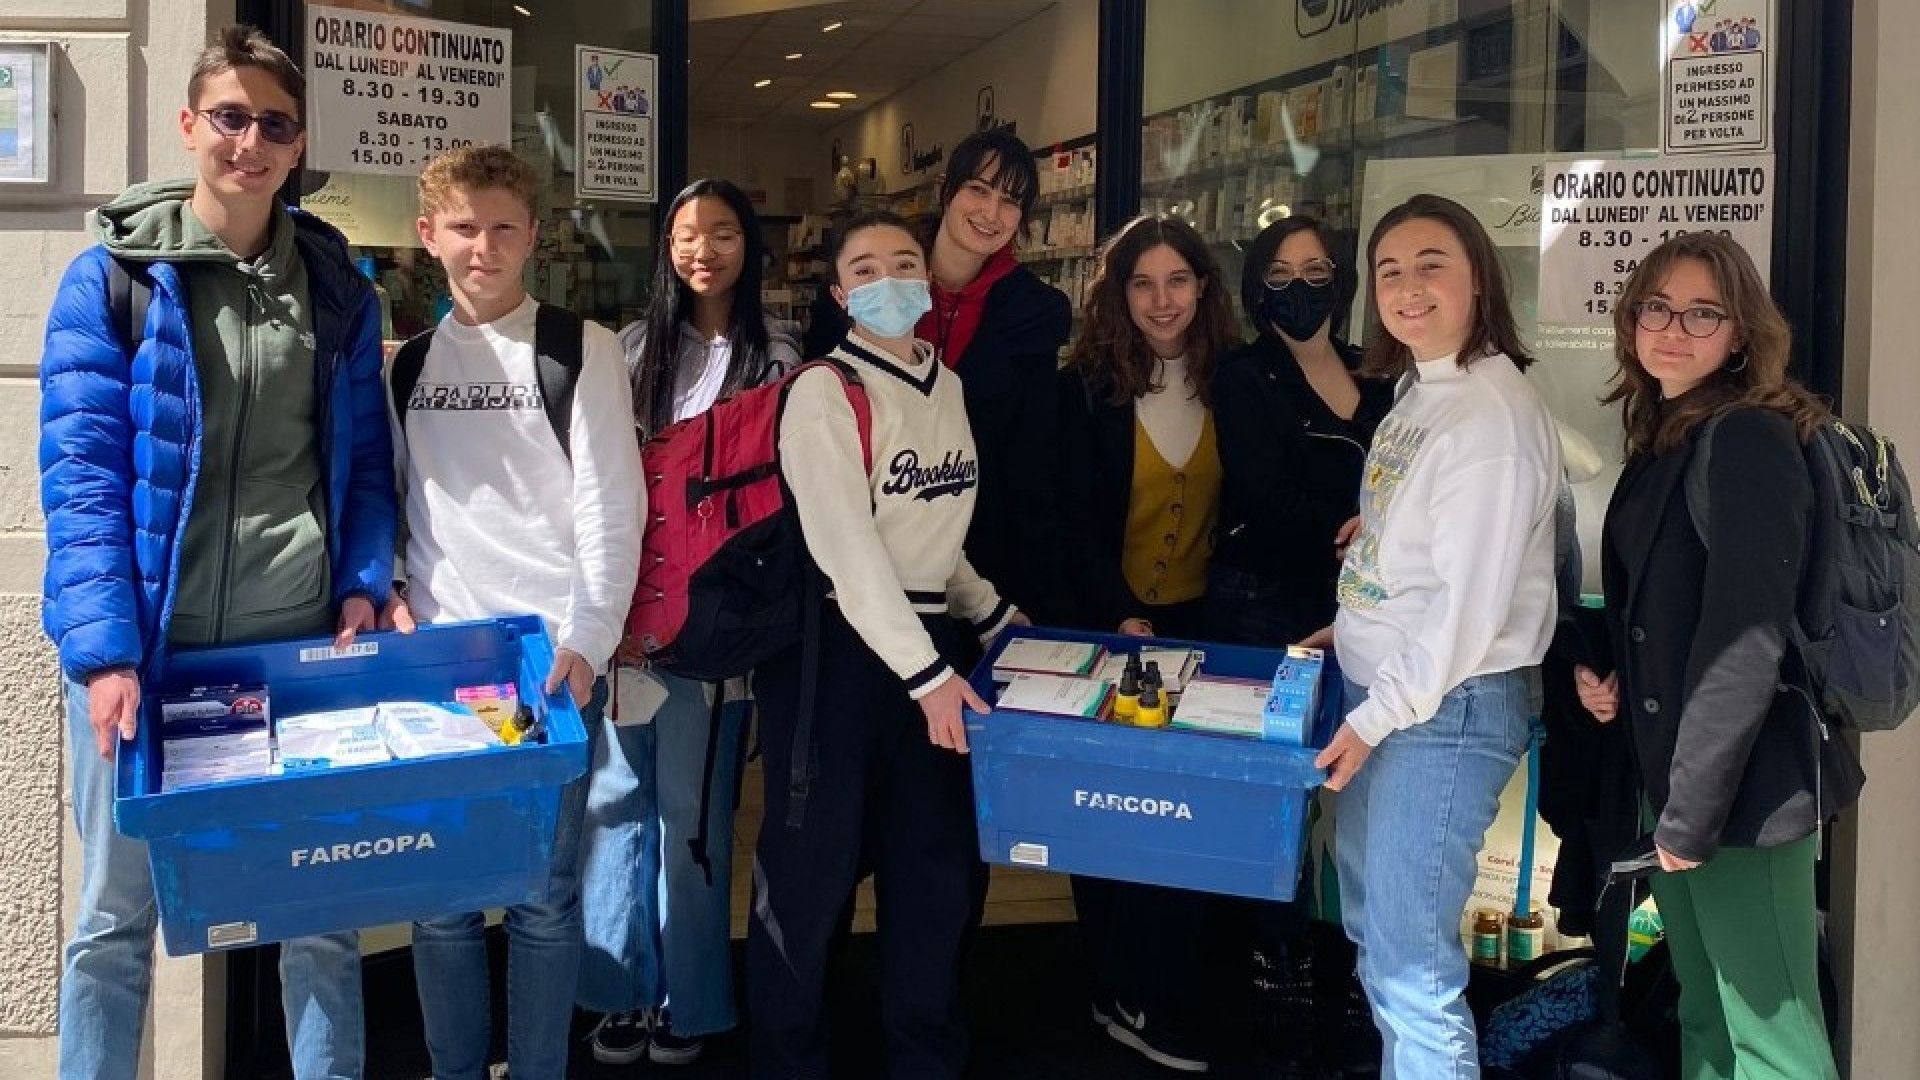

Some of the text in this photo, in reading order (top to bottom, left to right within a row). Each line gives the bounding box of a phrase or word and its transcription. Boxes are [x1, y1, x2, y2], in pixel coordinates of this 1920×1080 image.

[315, 16, 504, 65] ORARIO CONTINUATO
[315, 52, 505, 89] DAL LUNEDI' AL VENERDI'
[1686, 62, 1743, 77] INGRESSO
[342, 78, 394, 100] 8.30
[417, 87, 480, 109] 19.30
[1675, 77, 1755, 94] PERMESSO AD
[1679, 94, 1751, 109] UN MASSIMO
[377, 111, 447, 131] SABATO
[1674, 109, 1755, 125] DI 2 PERSONE
[595, 120, 637, 133] INGRESSO
[1683, 126, 1744, 141] PER VOLTA
[358, 131, 401, 148] 8.30
[588, 132, 632, 145] PERMESSO
[351, 149, 404, 167] 15.00
[604, 148, 643, 161] MASSIMO
[608, 162, 645, 174] PERSONE
[594, 173, 639, 187] PER VOLTA
[1553, 167, 1765, 199] ORARIO CONTINUATO
[1552, 203, 1765, 223] DAL LUNEDI' AL VENERDI'
[1578, 229, 1633, 247] 8.30
[1593, 281, 1623, 296] 8.3
[1585, 300, 1615, 315] 15.
[882, 448, 976, 497] Brooklyn
[1074, 789, 1193, 820] FARCOPA
[291, 832, 436, 868] FARCOPA
